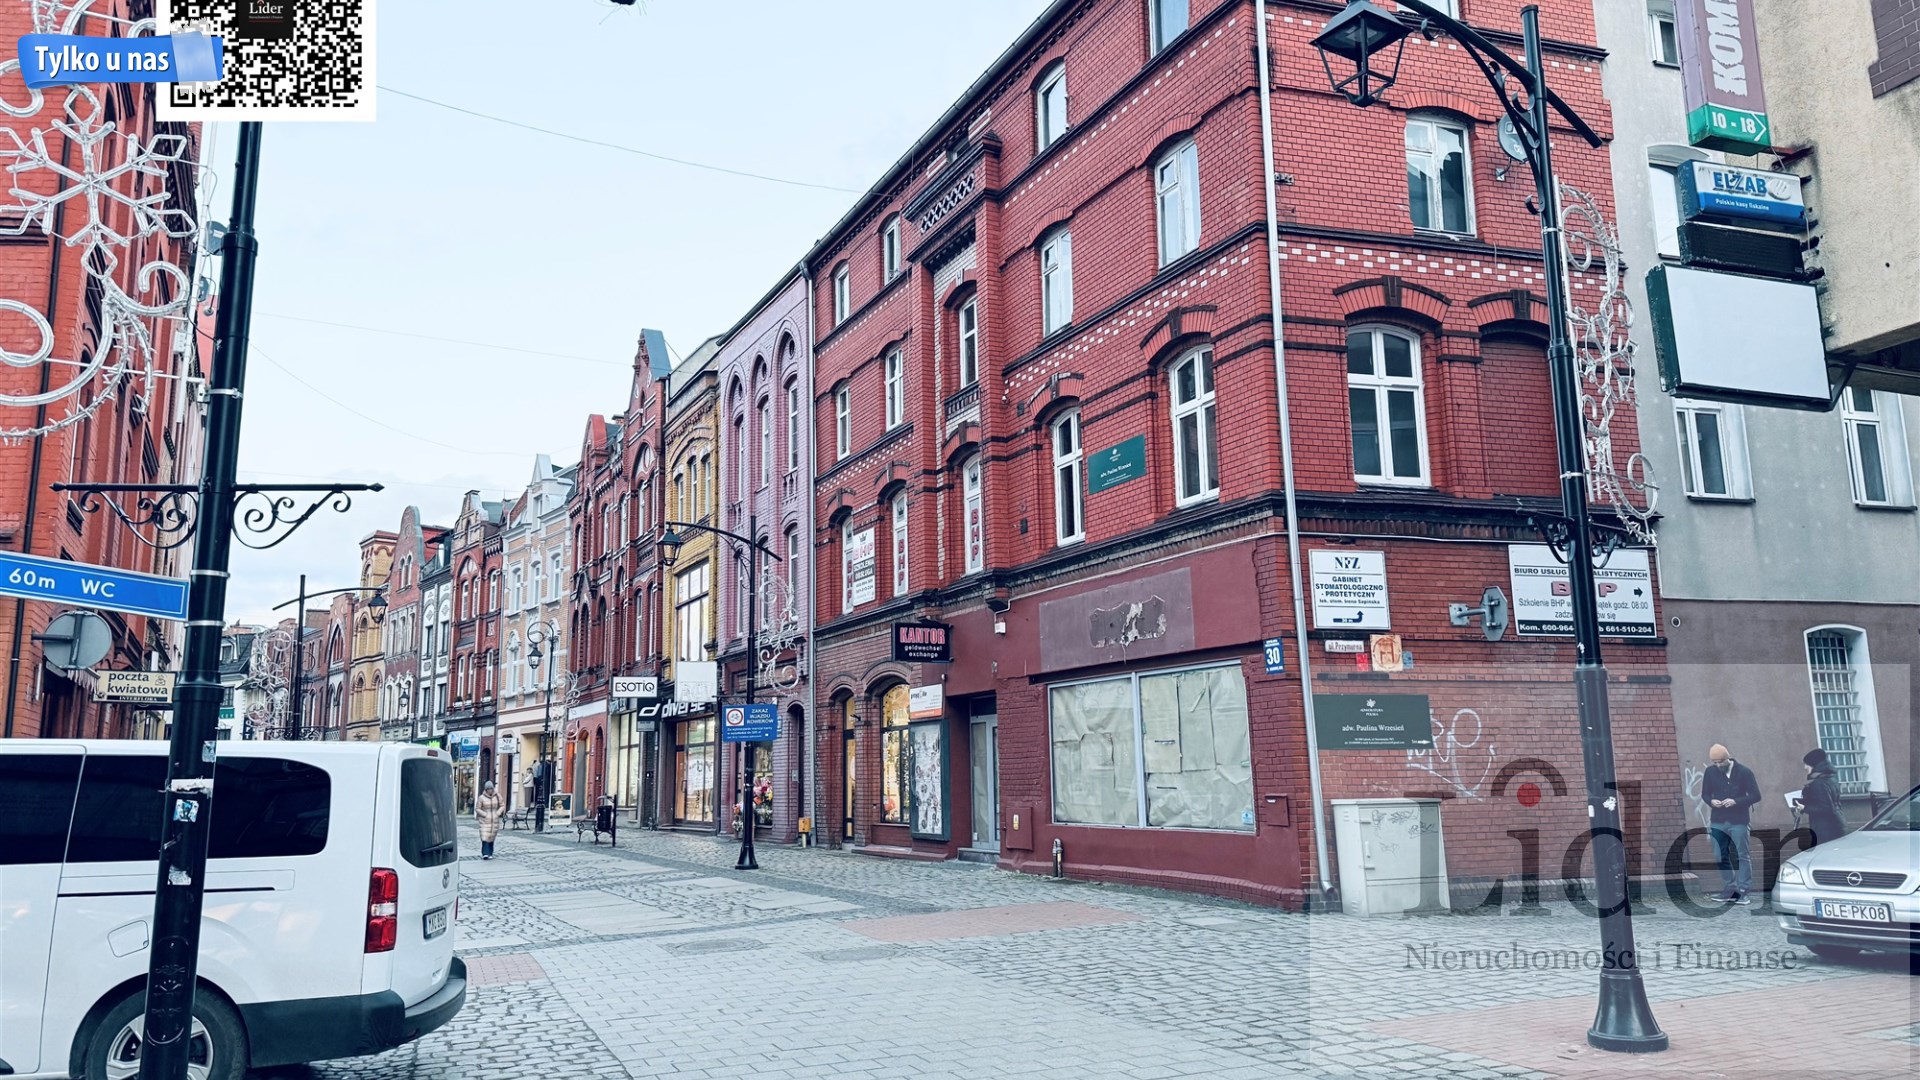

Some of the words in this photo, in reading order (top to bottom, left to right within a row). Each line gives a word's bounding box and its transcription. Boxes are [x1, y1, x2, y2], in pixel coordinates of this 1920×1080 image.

[1703, 0, 1748, 97] KOM
[1712, 111, 1727, 129] 10
[1740, 116, 1757, 134] 18
[1713, 171, 1768, 194] ELZAB
[1715, 198, 1735, 207] Polskie
[1736, 201, 1748, 209] kasy
[970, 508, 980, 562] BHP
[898, 538, 906, 587] BHP
[1514, 567, 1539, 575] BIURO
[1541, 568, 1567, 576] USŁUG
[1593, 570, 1648, 578] ALISTYCZNYCH
[8, 568, 56, 590] 60m
[80, 578, 116, 598] WC
[1315, 583, 1384, 591] STOMATOLOGICZNO
[1551, 581, 1618, 598] BP
[1325, 590, 1376, 598] PROTETYCZNY
[1518, 598, 1549, 608] Szkolenie
[1551, 598, 1565, 608] BHP
[899, 626, 946, 645] KANTOR
[1519, 623, 1540, 632] Kom.
[1542, 624, 1575, 632] 600-964-
[1605, 625, 1652, 633] 661-510-204
[1266, 647, 1280, 665] 30
[108, 671, 150, 683] poczta
[107, 682, 169, 696] kwiatowa
[661, 698, 705, 719] diverse
[1342, 724, 1355, 732] adw.
[1356, 724, 1378, 732] Paulina
[1378, 724, 1405, 732] Wrzesień
[1824, 903, 1849, 918] GLE
[1851, 905, 1887, 920] PK08
